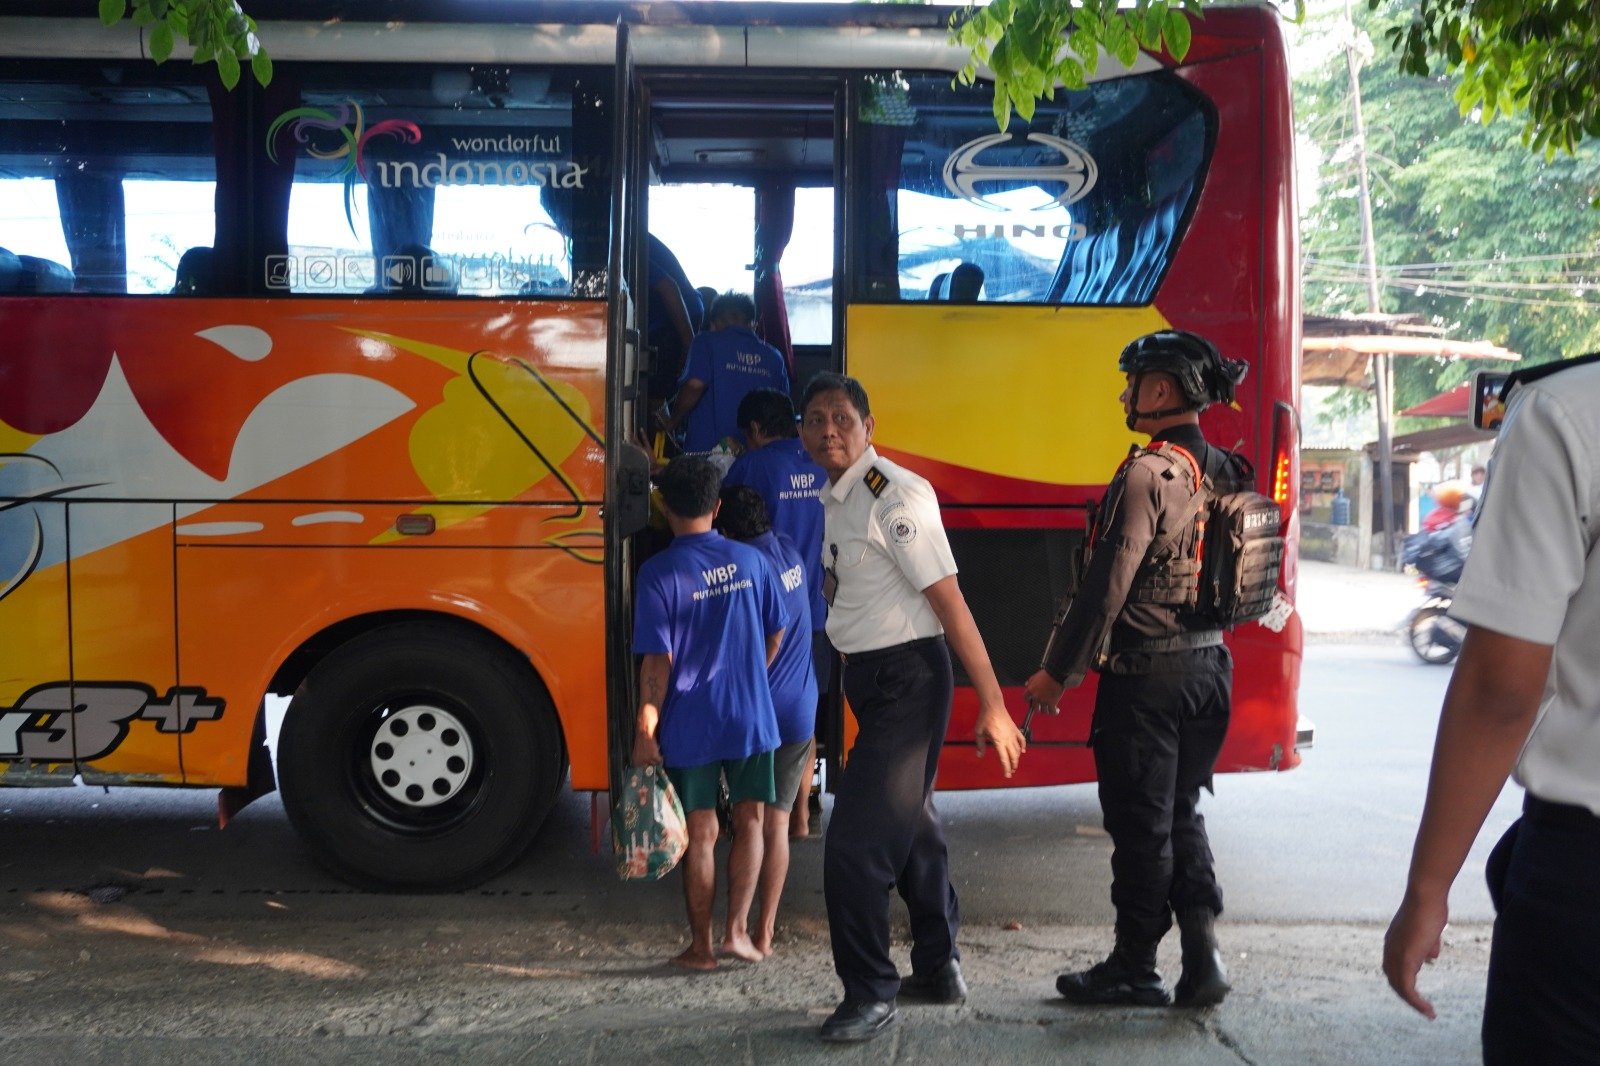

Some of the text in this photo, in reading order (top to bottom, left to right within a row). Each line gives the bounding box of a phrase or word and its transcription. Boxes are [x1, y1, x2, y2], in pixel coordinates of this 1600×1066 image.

[451, 133, 561, 154] wonderful
[954, 223, 1088, 241] HINO
[736, 350, 761, 366] WBP
[790, 473, 815, 490] WBP
[779, 490, 802, 500] RUTAN
[702, 563, 737, 587] WBP
[780, 564, 802, 593] WBP
[693, 586, 721, 602] RUTAN
